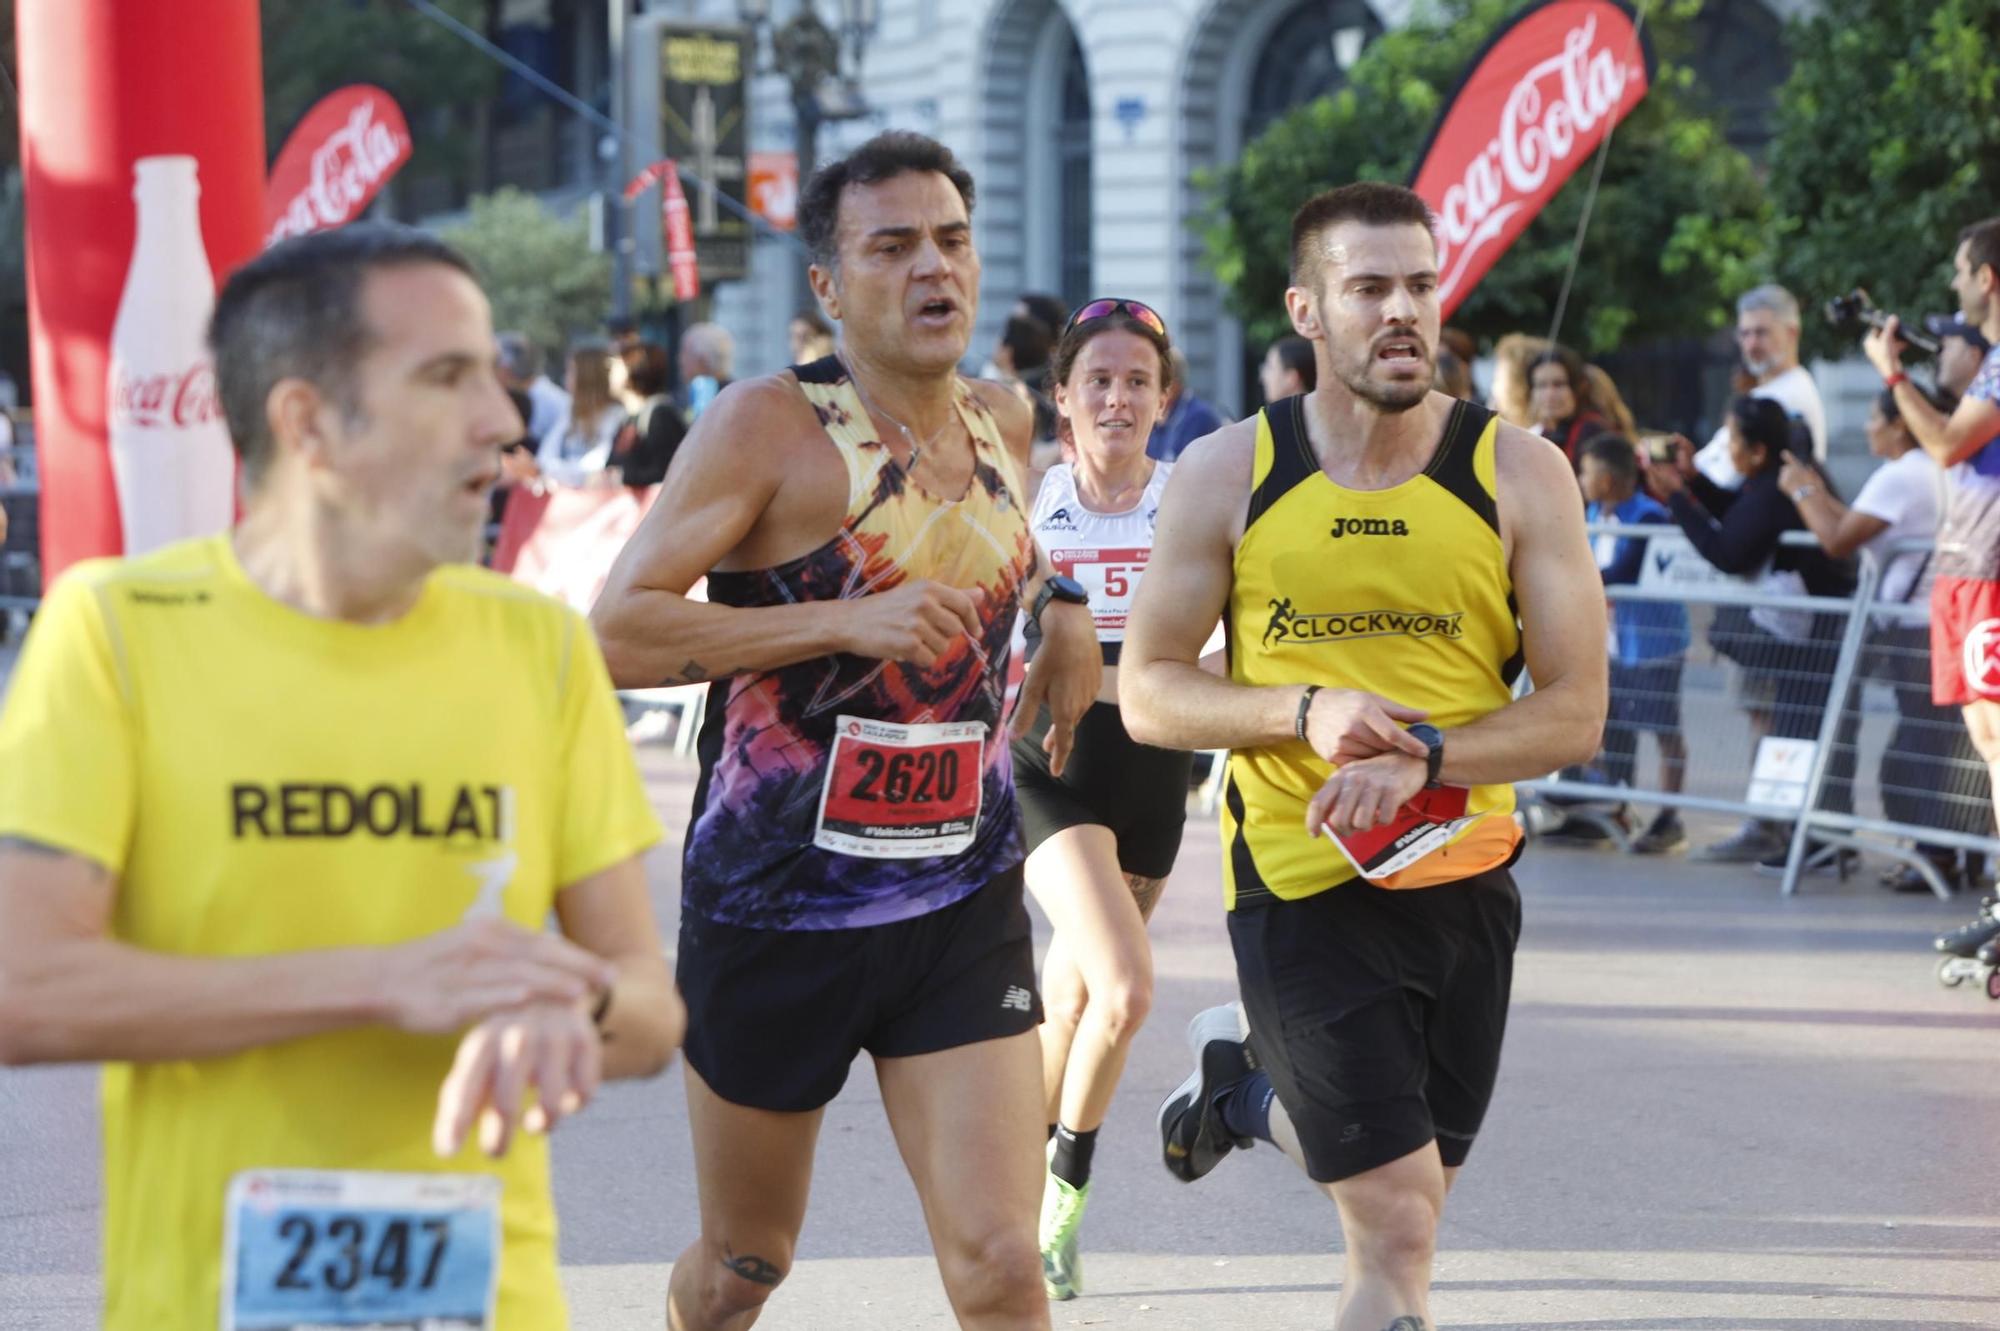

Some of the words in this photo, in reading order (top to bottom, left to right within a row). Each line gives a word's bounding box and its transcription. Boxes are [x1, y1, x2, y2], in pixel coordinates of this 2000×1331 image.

[1292, 613, 1463, 639] CLOCKWORK
[850, 748, 959, 804] 2620
[274, 1214, 452, 1293] 2347
